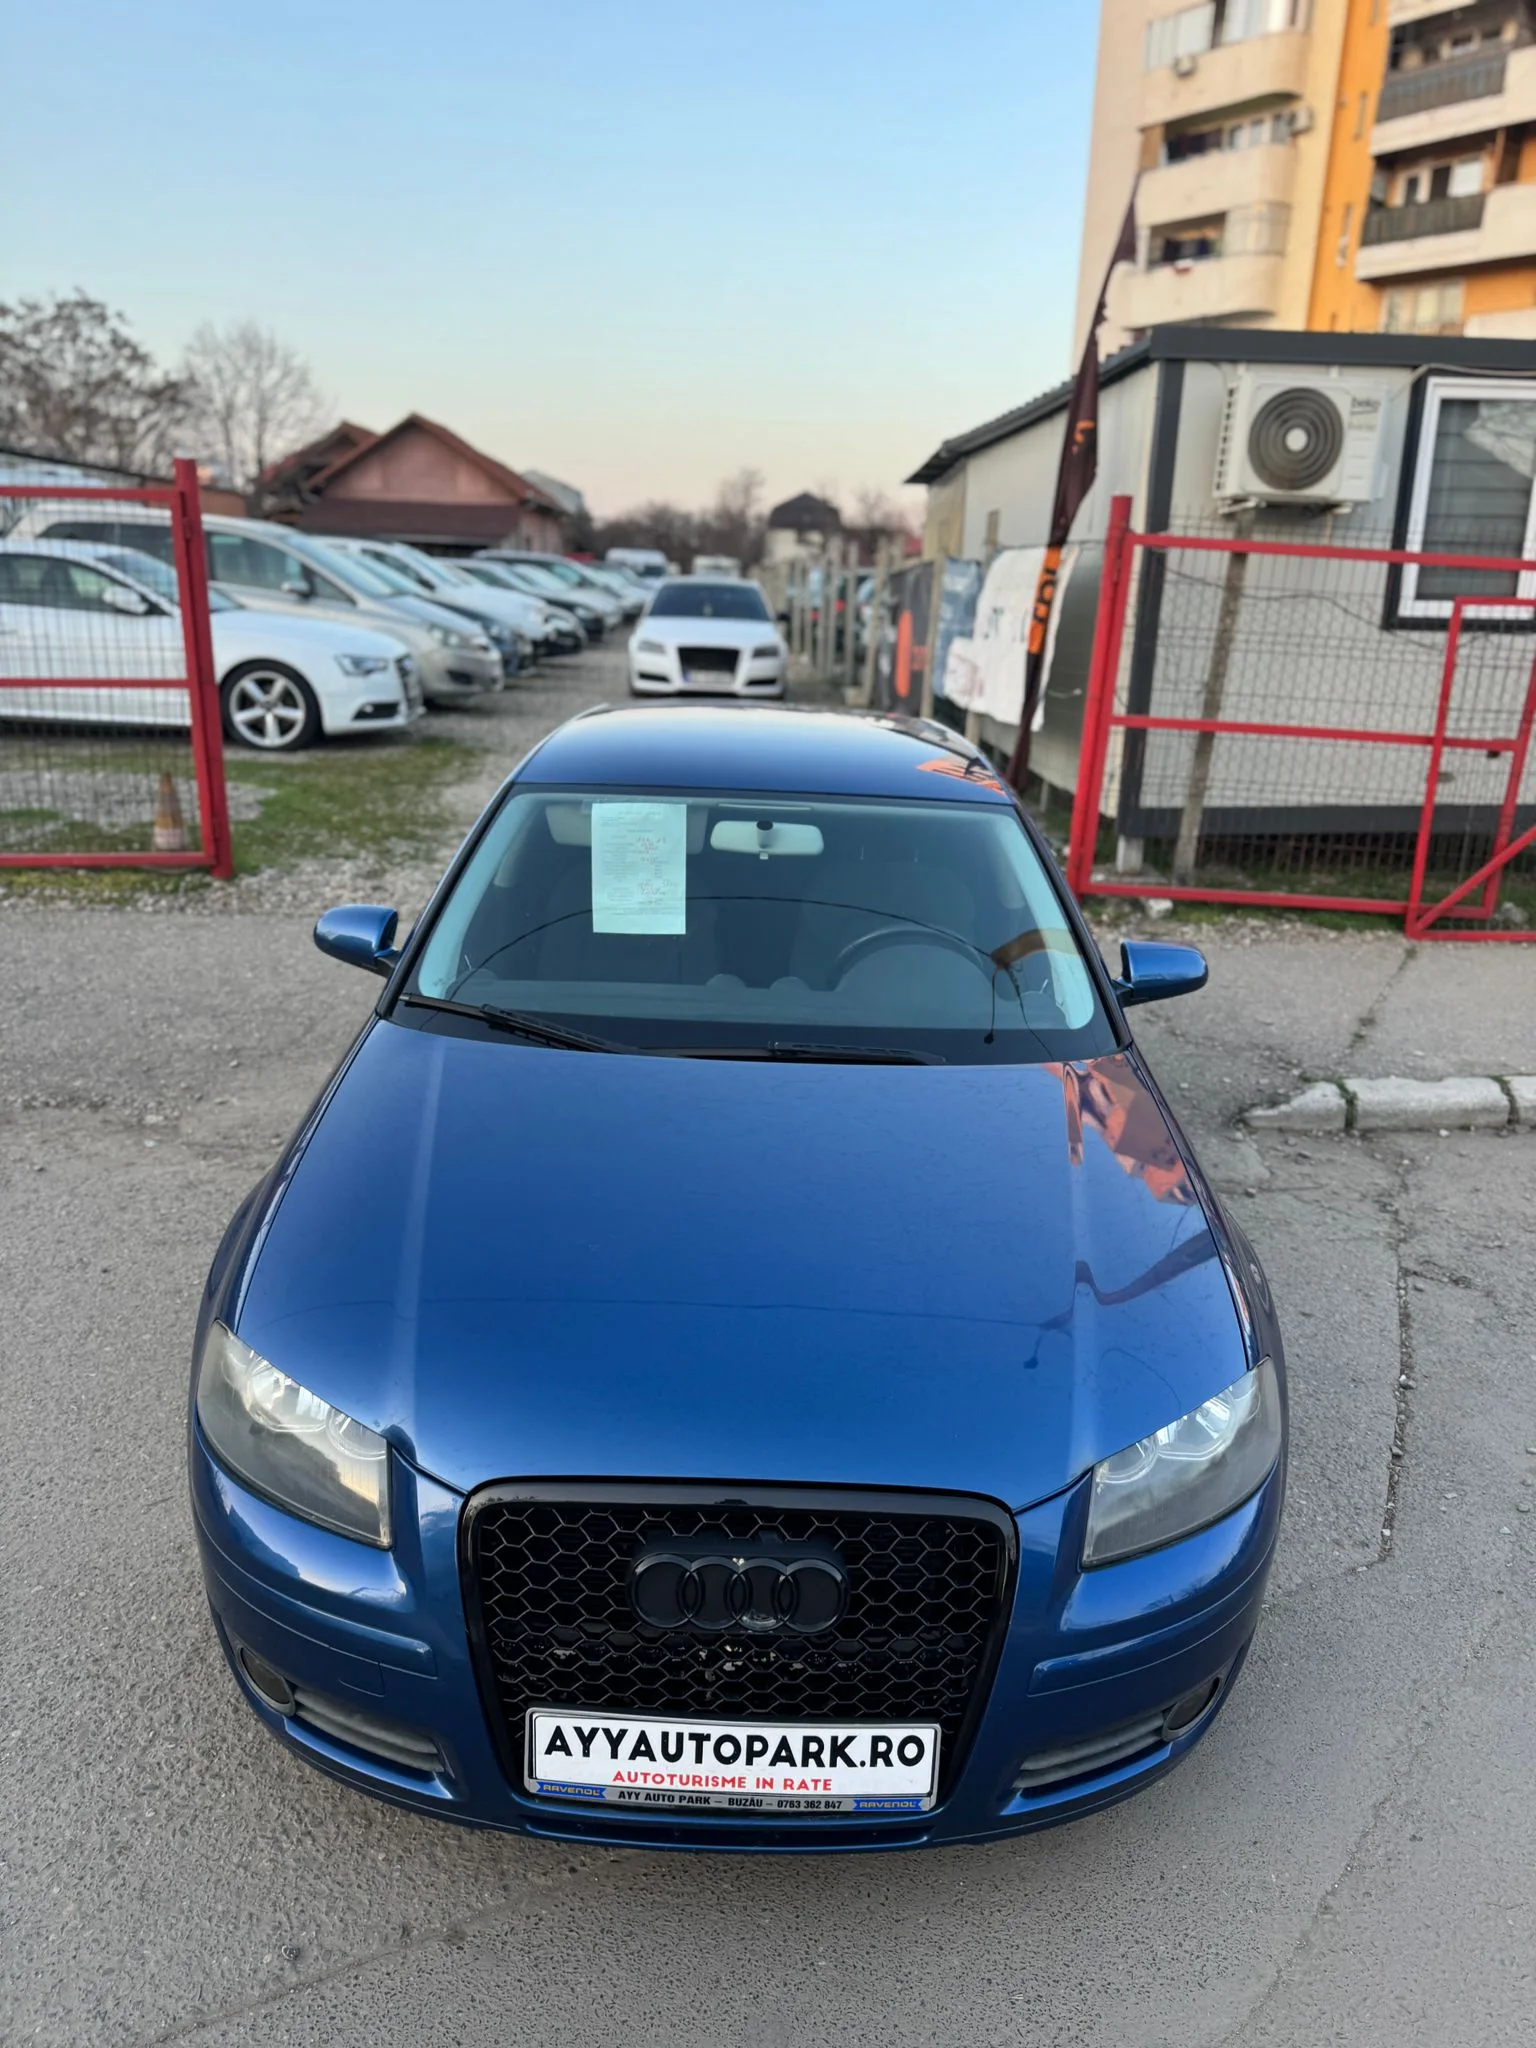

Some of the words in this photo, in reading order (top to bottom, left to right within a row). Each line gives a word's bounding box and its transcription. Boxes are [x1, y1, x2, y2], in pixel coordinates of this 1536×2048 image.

[544, 1725, 925, 1768] AYYAUTOPARK.RO
[543, 1784, 601, 1796] RAVENOL
[612, 1770, 747, 1789] AUTOTURISME
[755, 1777, 775, 1790] IN
[783, 1778, 833, 1791] RATE
[618, 1790, 641, 1801] AYY
[644, 1792, 675, 1803] AUTO
[678, 1795, 711, 1805] PARK
[777, 1799, 801, 1809] 0763
[803, 1800, 821, 1809] 362
[824, 1800, 842, 1810] 847
